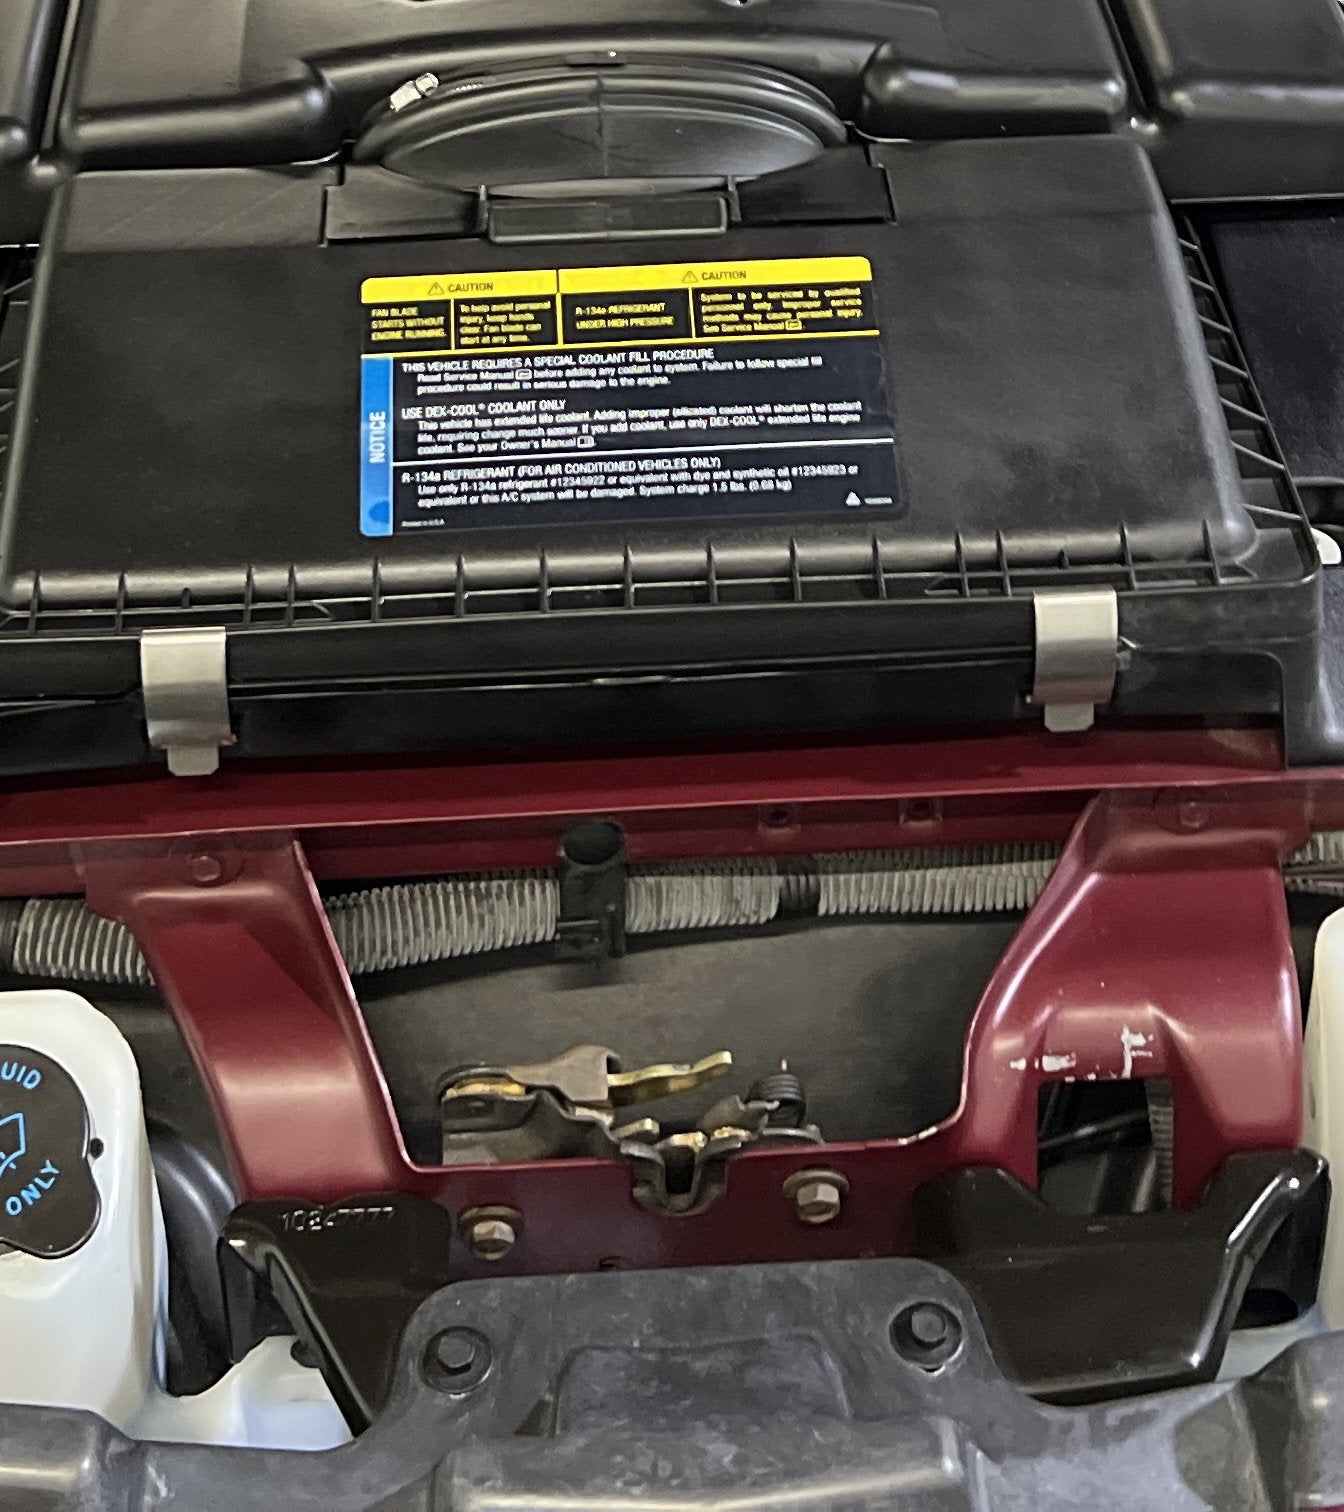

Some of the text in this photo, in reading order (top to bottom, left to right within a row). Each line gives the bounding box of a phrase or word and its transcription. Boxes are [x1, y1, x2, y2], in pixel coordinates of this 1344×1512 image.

[448, 281, 494, 292] CAUTION
[701, 269, 747, 281] CAUTION
[401, 348, 714, 372] THIS VEHICLE REQUIRES A SPECIAL COOLANT FILL PROCEDURE
[443, 372, 477, 381] Service
[479, 370, 514, 379] Manual
[533, 369, 563, 378] before
[565, 367, 596, 377] adding
[598, 367, 615, 376] any
[617, 364, 651, 374] coolant
[652, 363, 662, 372] to
[664, 362, 699, 373] system.
[701, 360, 733, 370] Failure
[734, 360, 745, 369] to
[746, 358, 774, 368] follow
[776, 357, 809, 368] special
[417, 384, 464, 394] procedure
[466, 382, 492, 391] could
[493, 381, 520, 390] result
[568, 379, 606, 388] damage
[608, 377, 618, 386] to
[619, 377, 635, 386] the
[636, 376, 670, 386] engine.
[401, 406, 422, 419] USE
[487, 400, 536, 414] COOLANT
[538, 399, 565, 410] ONLY
[418, 420, 438, 430] This
[439, 419, 472, 429] vehicle
[474, 417, 492, 427] has
[493, 414, 536, 426] extended
[538, 413, 553, 423] life
[593, 409, 626, 420] Adding
[628, 409, 669, 418] improper
[717, 405, 753, 416] coolant
[753, 404, 771, 414] will
[773, 403, 808, 412] shorten
[809, 402, 825, 412] the
[827, 401, 862, 411] coolant
[369, 411, 386, 464] NOTICE
[436, 431, 479, 441] requiring
[480, 429, 516, 439] change
[517, 427, 545, 436] much
[581, 423, 588, 436] If
[590, 424, 608, 435] you
[609, 421, 628, 432] add
[668, 419, 685, 429] use
[687, 418, 707, 428] only
[766, 414, 810, 424] extended
[811, 413, 826, 422] life
[828, 413, 860, 423] engine
[457, 441, 476, 452] See
[476, 442, 497, 452] your
[500, 440, 539, 449] Owner's
[541, 437, 576, 447] Manual
[401, 456, 720, 482] R-134a REFRIGERANT (FOR AIR CONDITIONED VEHICLES ONLY)
[417, 484, 436, 494] Use
[438, 483, 458, 493] only
[460, 481, 496, 491] R-134a
[498, 479, 548, 490] refrigerant
[607, 476, 617, 484] or
[619, 472, 668, 484] equivalent
[670, 471, 691, 481] with
[692, 471, 710, 481] dye
[712, 469, 730, 479] and
[732, 467, 775, 479] synthetic
[777, 466, 789, 476] oil
[847, 465, 858, 474] or
[417, 494, 467, 507] equivalent
[469, 495, 479, 504] or
[481, 494, 499, 503] this
[500, 491, 518, 501] A/C
[519, 491, 554, 502] system
[556, 489, 573, 499] will
[575, 489, 588, 498] be
[589, 487, 636, 497] damaged.
[639, 485, 674, 496] System
[676, 483, 709, 494] charge
[5, 1159, 60, 1217] ONLY
